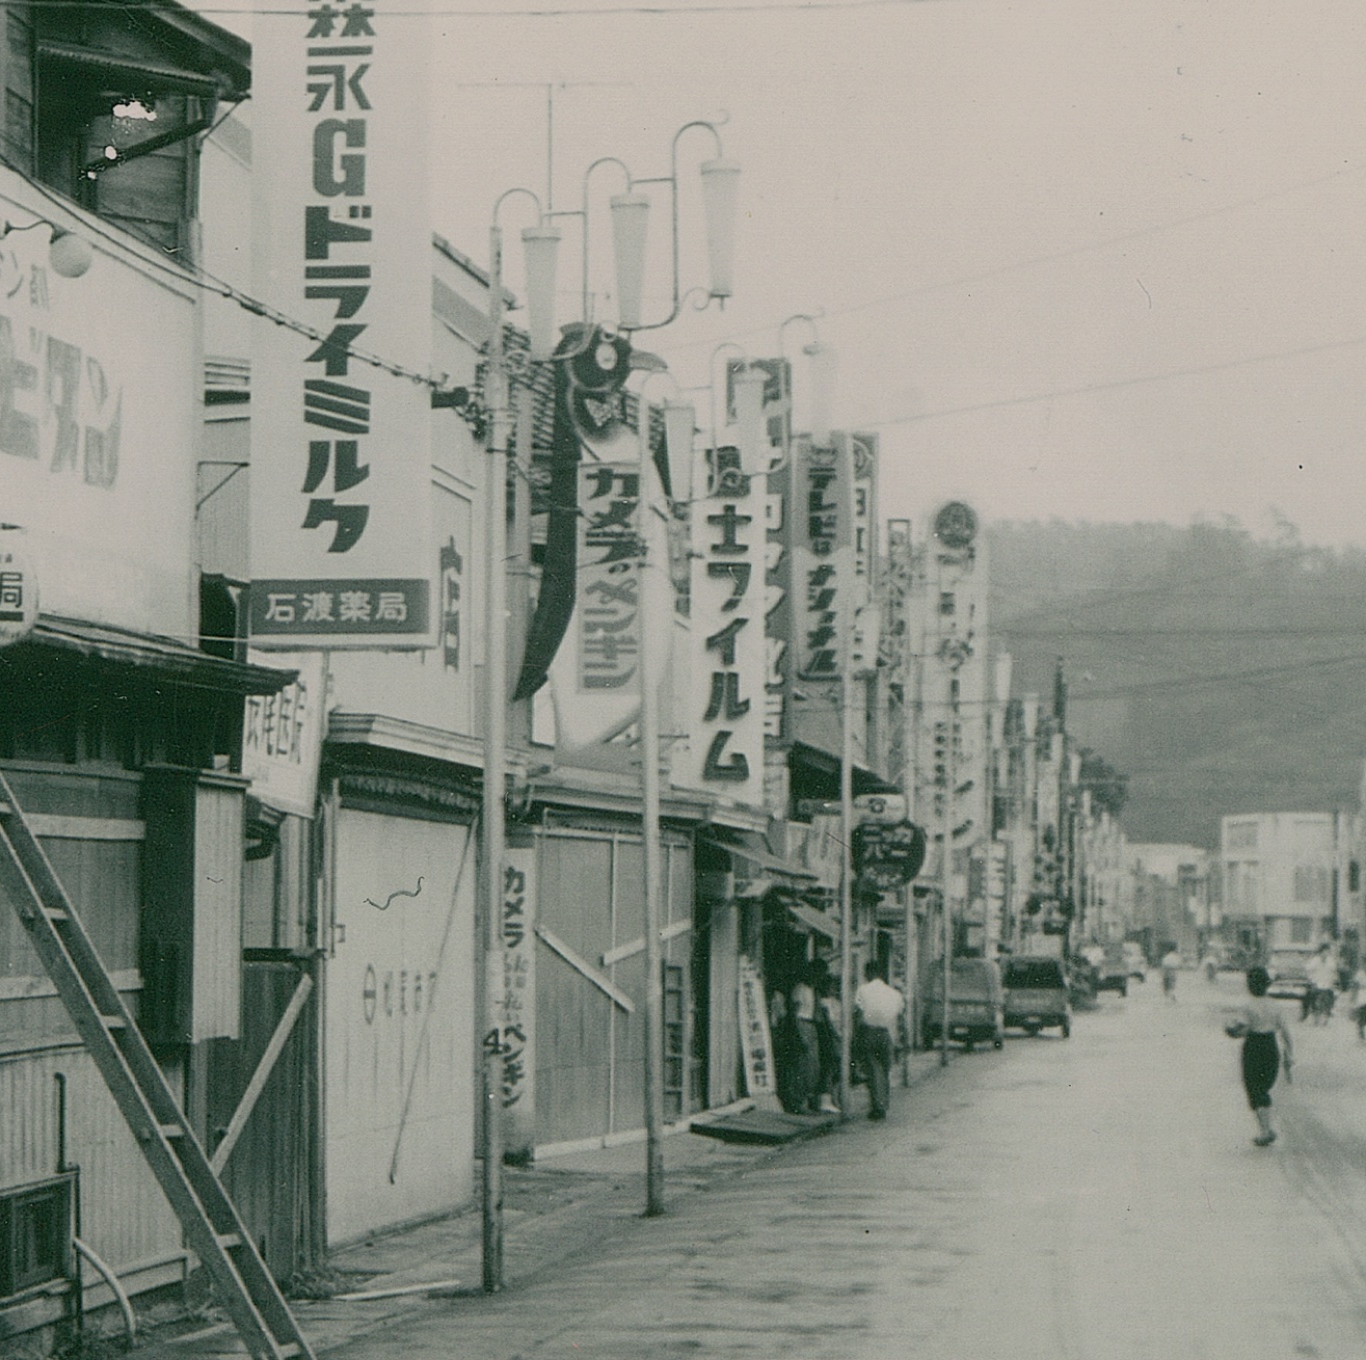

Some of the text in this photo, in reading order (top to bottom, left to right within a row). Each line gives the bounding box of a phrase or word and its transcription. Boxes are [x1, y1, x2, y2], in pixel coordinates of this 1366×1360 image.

[265, 592, 408, 621] 石渡薬局
[503, 866, 526, 949] カメラ
